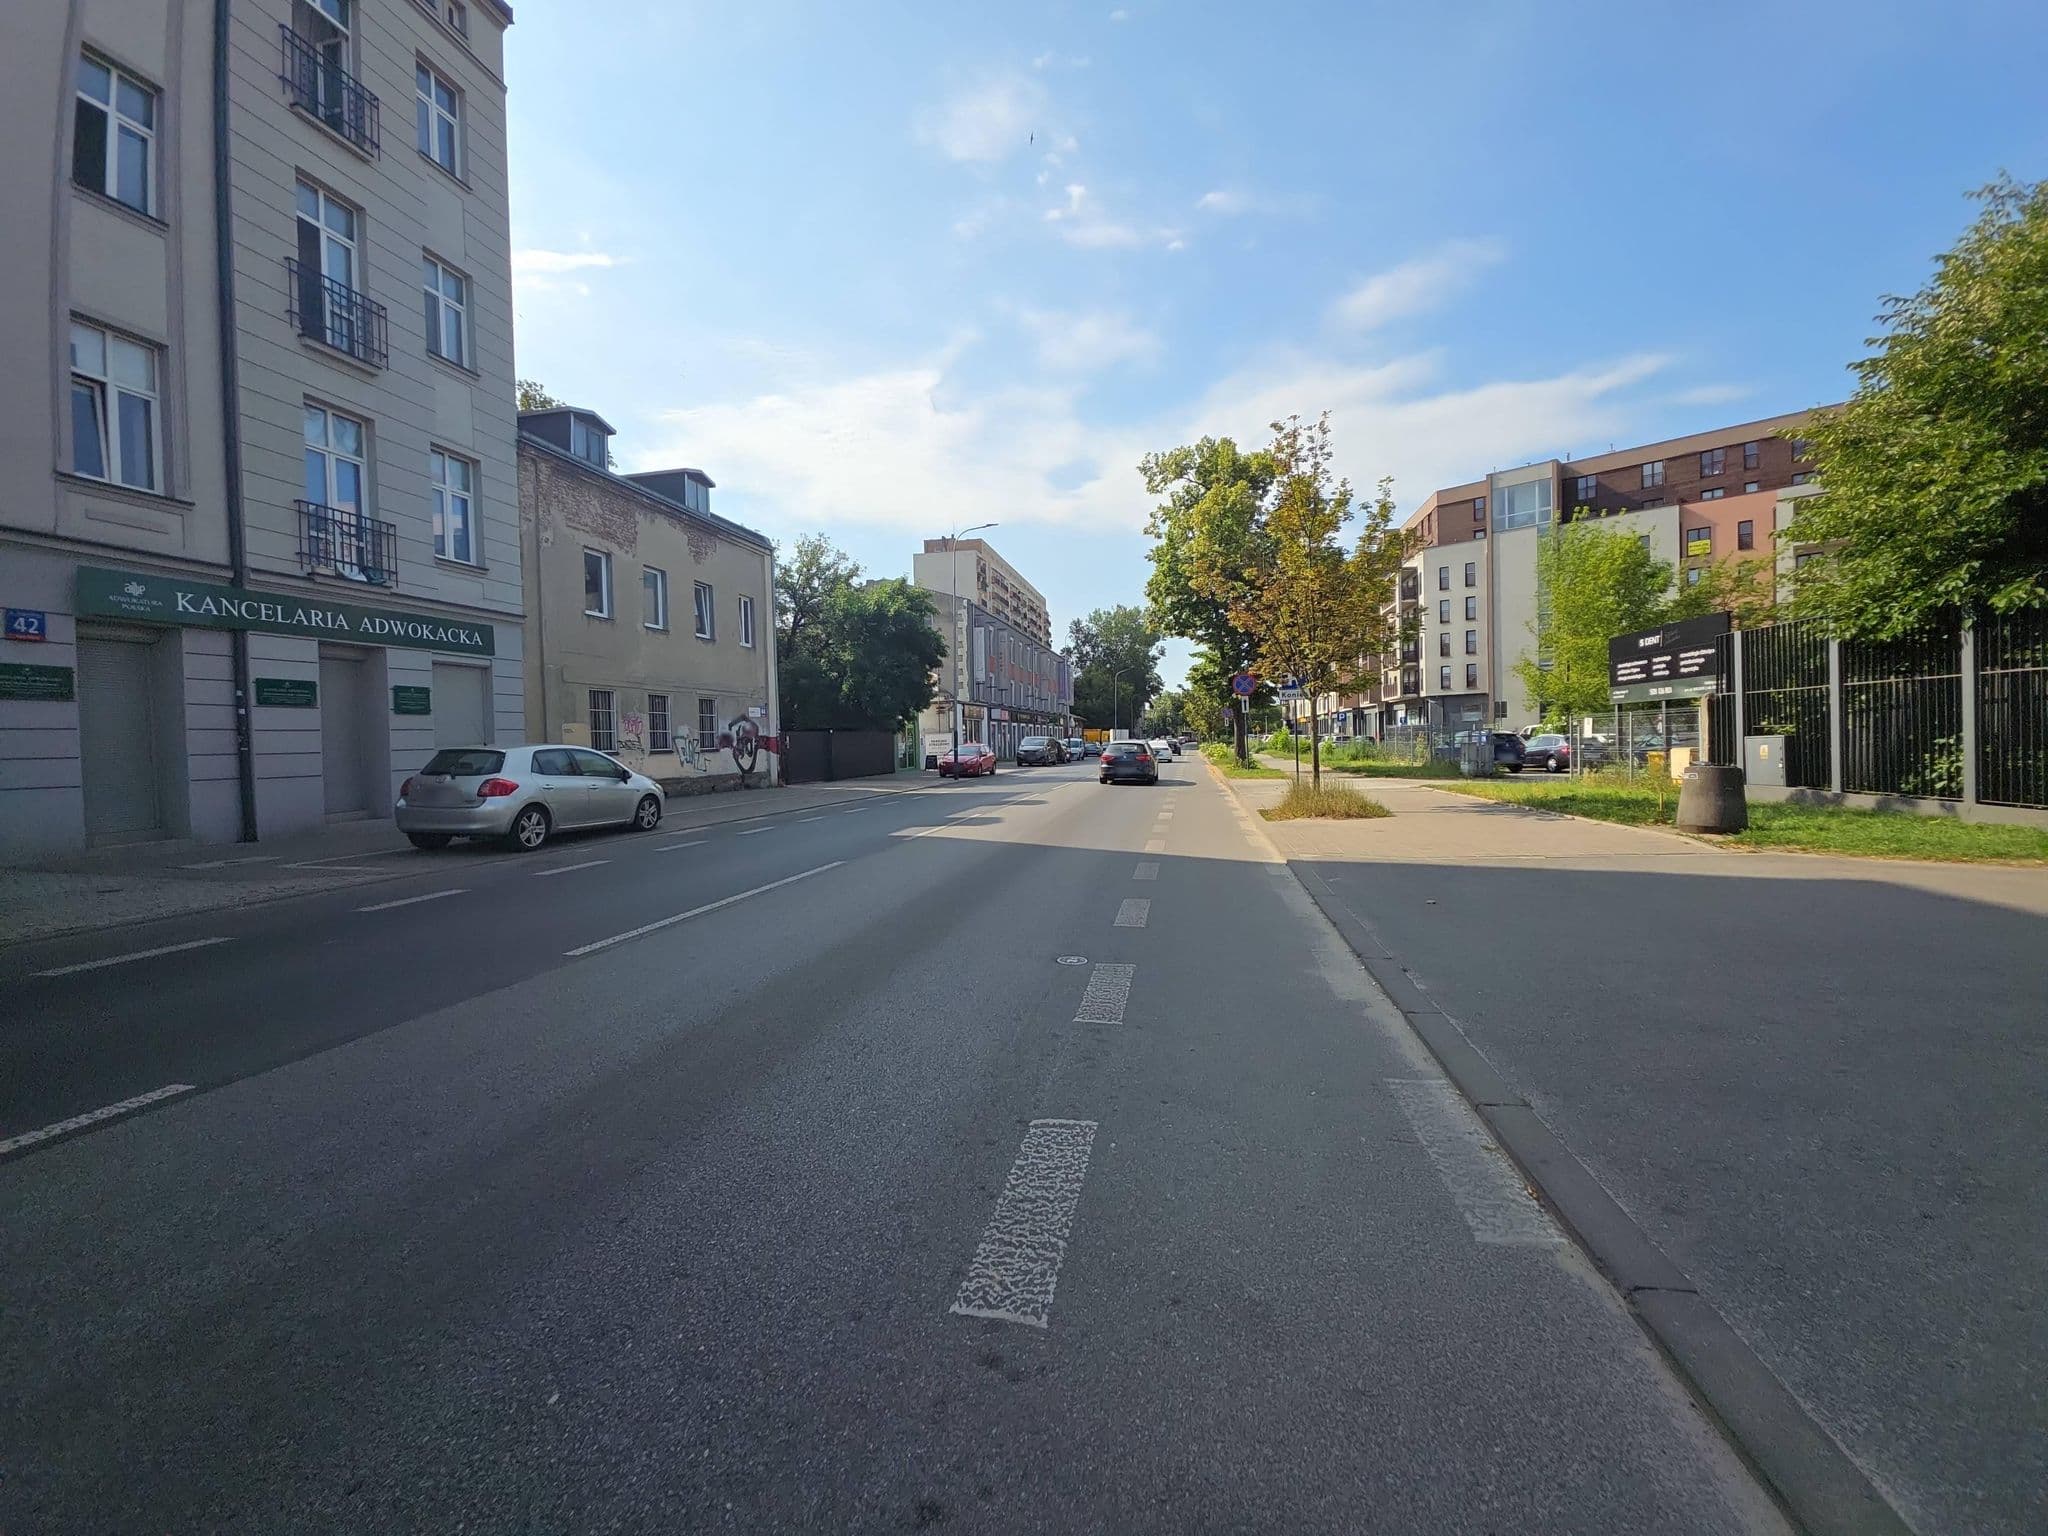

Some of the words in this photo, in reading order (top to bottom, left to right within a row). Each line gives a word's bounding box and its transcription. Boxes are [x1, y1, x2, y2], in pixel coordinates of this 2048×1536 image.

[13, 617, 39, 634] 42
[175, 591, 350, 630] KANCELARIA
[359, 617, 483, 646] ADWOKACKA
